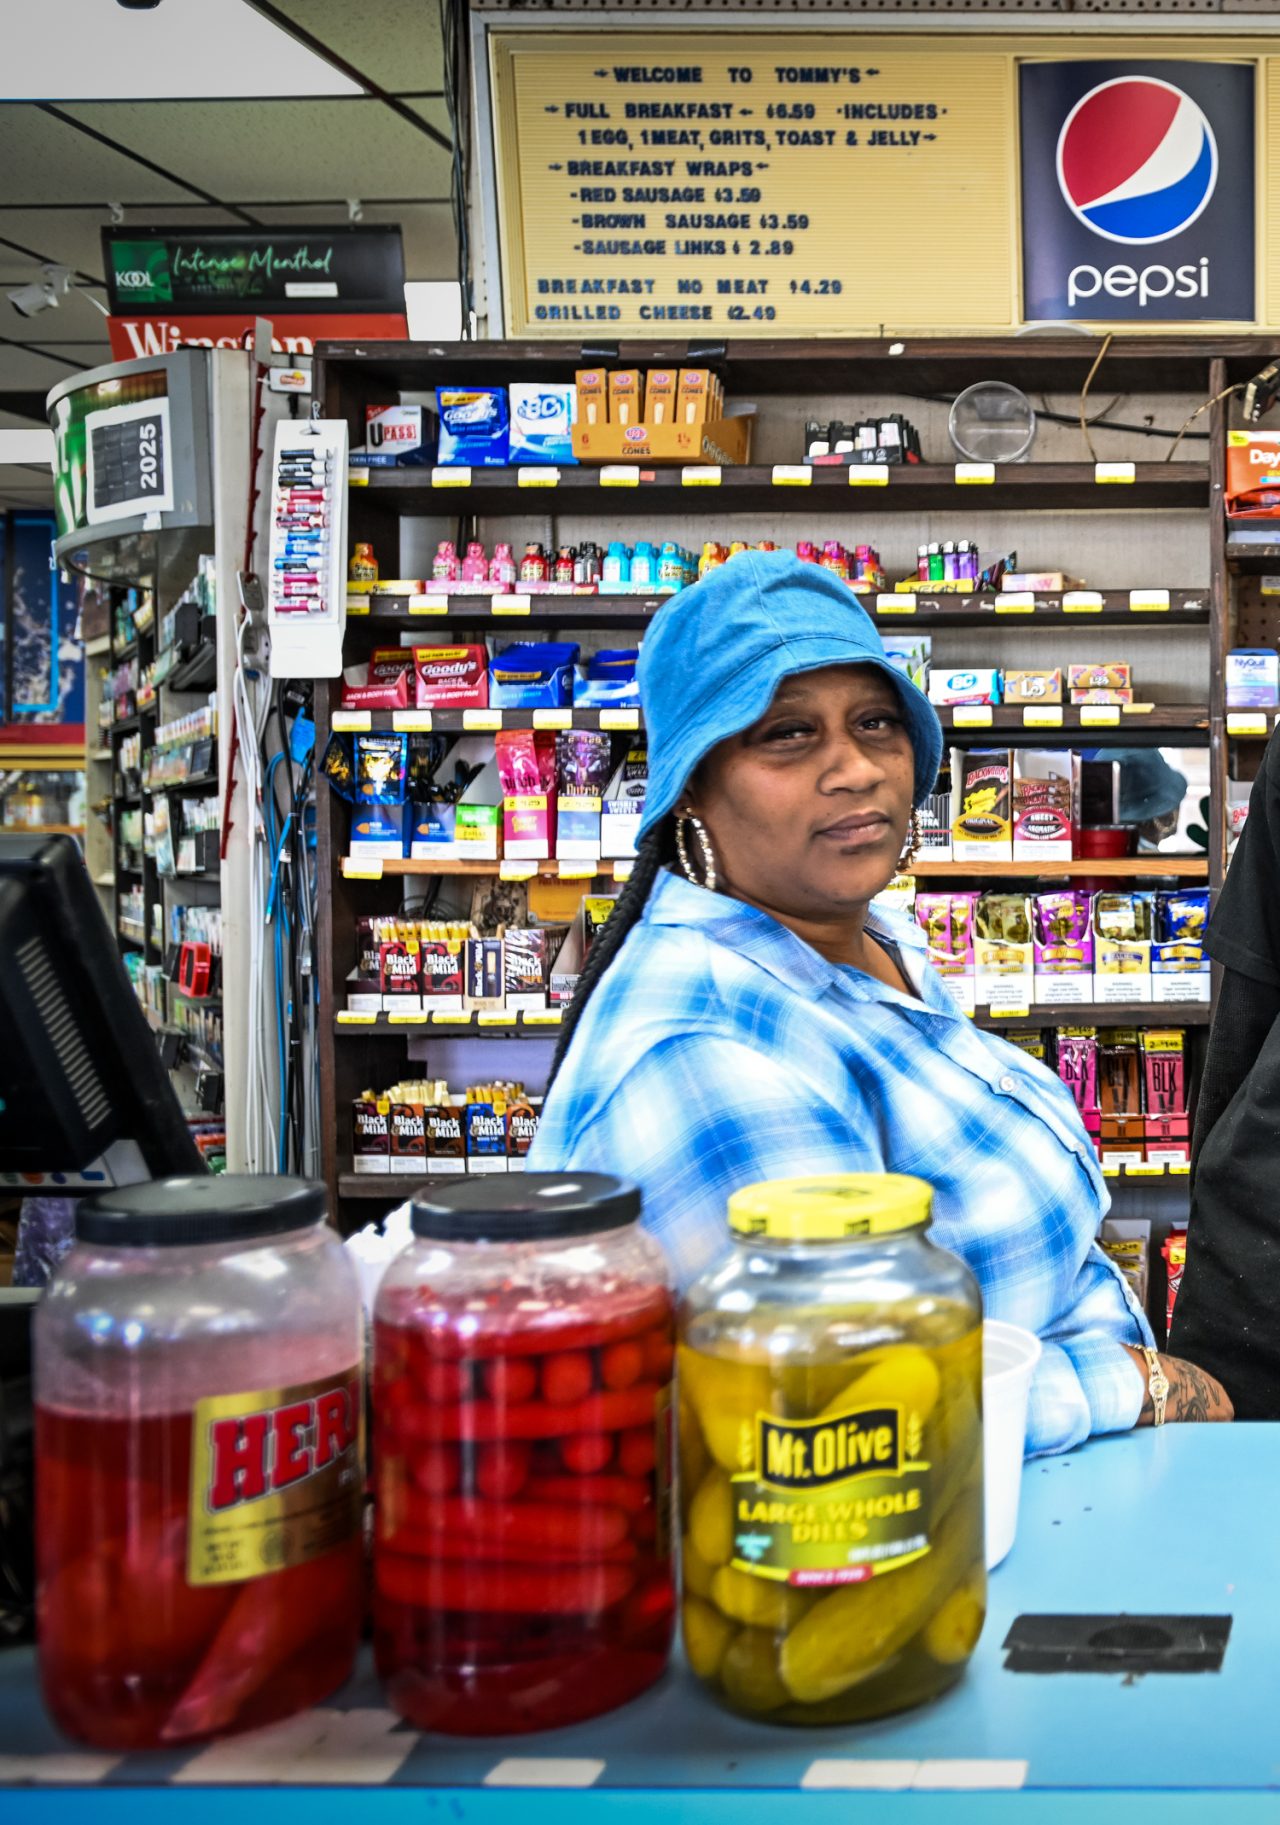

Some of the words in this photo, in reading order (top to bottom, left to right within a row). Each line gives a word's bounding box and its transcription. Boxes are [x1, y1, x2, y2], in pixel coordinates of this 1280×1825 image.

[613, 67, 702, 83] WELCOME
[728, 67, 752, 83] TO
[775, 67, 860, 83] TOMMY'S
[565, 103, 610, 118] FULL
[625, 103, 733, 118] BREAKFAST
[845, 104, 937, 119] INCLUDES
[775, 130, 835, 145] TOAST
[846, 130, 857, 146] &
[868, 131, 920, 145] JELLY
[567, 161, 674, 176] BREAKFAST
[686, 161, 752, 176] WRAPS
[580, 188, 616, 202] RED
[623, 188, 704, 203] SAUSAGE
[581, 214, 645, 228] BROWN
[665, 214, 750, 228] SAUSAGE
[583, 240, 665, 254] SAUSAGE
[675, 240, 726, 255] LINKS
[173, 246, 246, 275] Intense
[248, 246, 332, 278] Menthol
[115, 271, 154, 287] KOOL
[538, 279, 654, 293] BREAKFAST
[678, 280, 702, 294] NO
[717, 280, 768, 293] MEAT
[1068, 257, 1209, 307] pepsi
[535, 306, 620, 320] GRILLED
[640, 306, 712, 320] CHEESE
[140, 422, 158, 490] 2025
[421, 660, 478, 678] Goody's
[1234, 658, 1266, 668] NyQuil
[951, 673, 973, 688] BC
[966, 766, 1009, 789] BACKWOODS
[1152, 1062, 1177, 1093] BLK
[429, 1117, 460, 1128] Black
[472, 1115, 504, 1126] Black
[436, 1127, 461, 1138] Mild
[479, 1125, 505, 1136] Mild
[767, 1427, 811, 1479] Mt.
[812, 1422, 893, 1476] Olive
[737, 1500, 818, 1525] LARGE
[824, 1488, 922, 1523] WHOLE
[791, 1521, 868, 1544] DILLS
